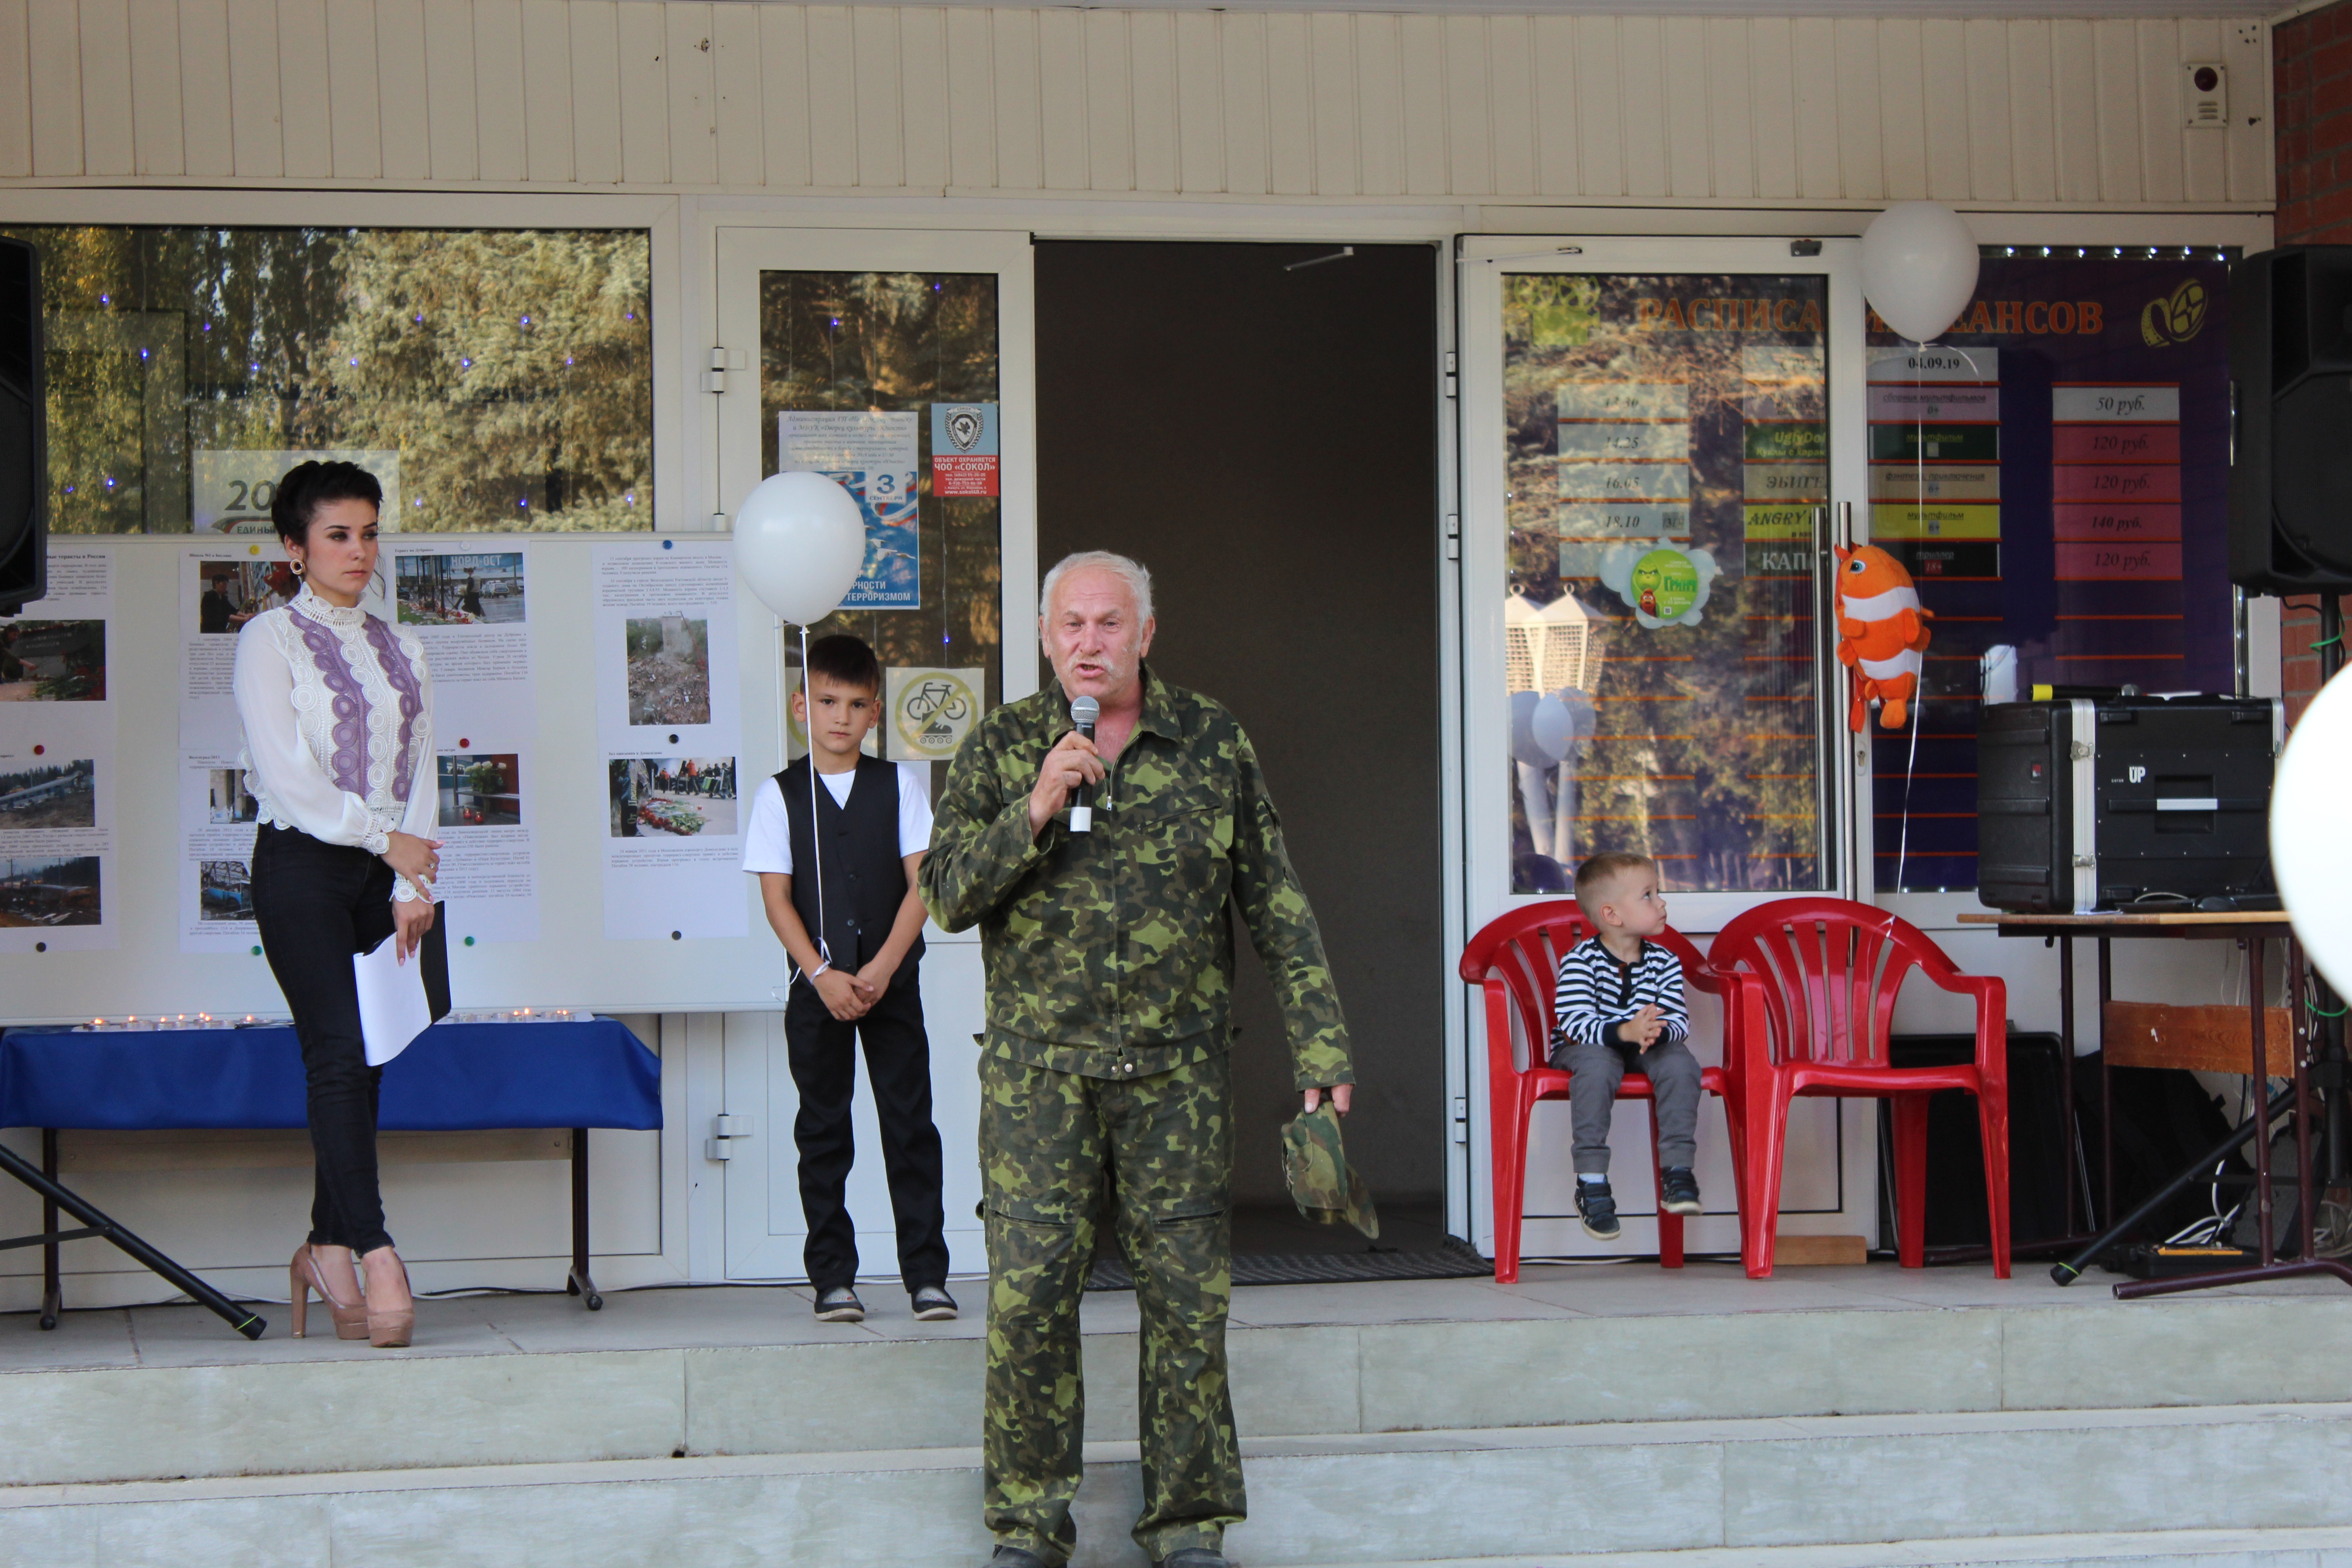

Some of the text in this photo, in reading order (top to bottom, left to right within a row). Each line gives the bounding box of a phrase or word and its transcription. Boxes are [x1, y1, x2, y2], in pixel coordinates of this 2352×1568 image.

[1637, 298, 2103, 334] РАСПИСА АНСОВ
[1908, 358, 1960, 369] 04.09.19
[2096, 395, 2145, 416] 50 руб.
[1774, 431, 1826, 446] UglyDol
[2093, 433, 2149, 455] 120 руб.
[934, 463, 995, 471] ЧОО «СОКОЛ»
[1606, 477, 1640, 489] 16.05
[1766, 476, 1827, 489] ЭБИГЕ
[1929, 473, 1985, 481] приключения
[2094, 473, 2150, 494] 120 руб.
[876, 474, 896, 494] 3
[1606, 515, 1640, 528] 18.10
[1748, 511, 1807, 525] ANGRY
[2092, 516, 2142, 532] 140 руб.
[237, 526, 276, 534] ЕДИНЫ
[1928, 524, 1940, 532] 6+
[451, 555, 502, 567] НОРД-ОСТ
[1761, 552, 1813, 570] КАП
[1916, 551, 1955, 560] триллер
[2094, 551, 2151, 571] 120 руб.
[1926, 563, 1943, 572] 18+
[851, 581, 886, 589] РНОСТИ
[847, 592, 911, 601] ТЕРРОРИЗМОМ
